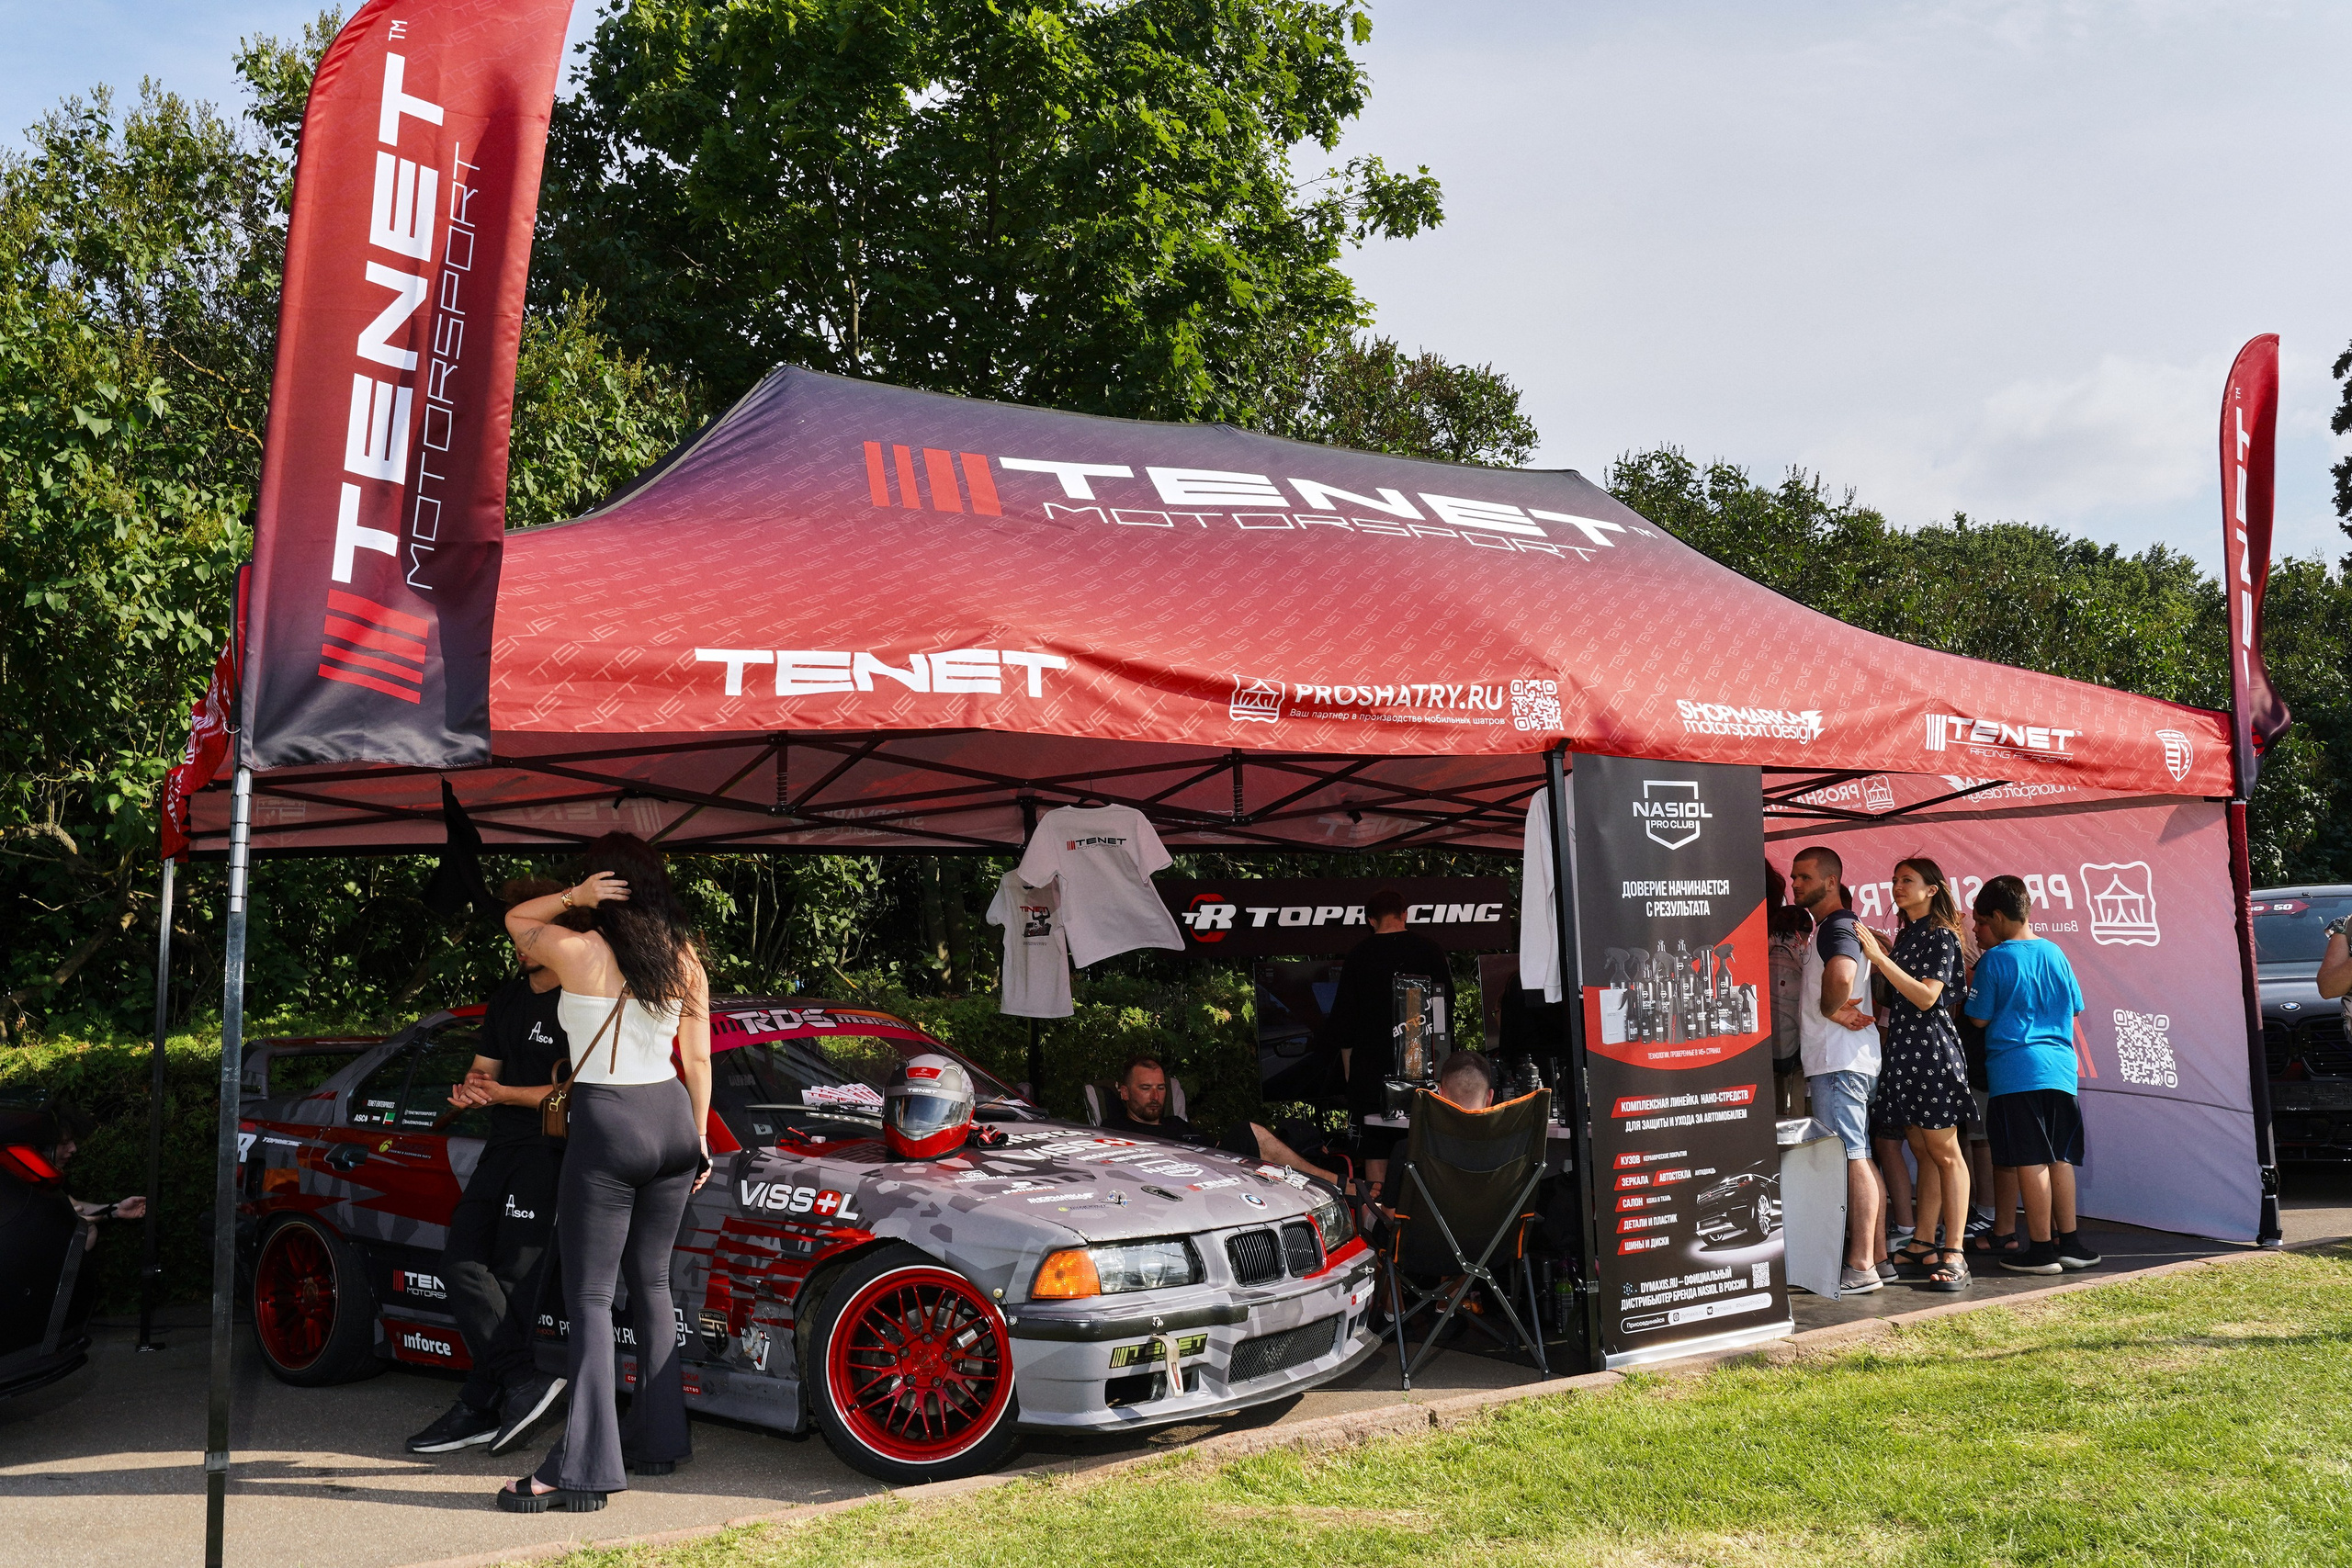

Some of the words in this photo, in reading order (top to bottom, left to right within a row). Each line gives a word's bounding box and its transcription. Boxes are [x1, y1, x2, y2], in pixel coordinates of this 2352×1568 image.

[331, 52, 444, 583] TENET
[407, 142, 480, 590] MOTORSPORT
[998, 457, 1629, 547] TENET
[1043, 502, 1599, 562] MOTORSPORT
[695, 648, 1069, 698] TENET
[1294, 683, 1503, 710] PROSHATRY.RU
[1289, 708, 1309, 717] Ваш
[1312, 711, 1349, 721] партнер
[1359, 713, 1422, 723] производстве
[1424, 715, 1471, 725] мобильных
[1473, 716, 1505, 726] шатров
[1677, 699, 1808, 725] SHOPMARKA
[1683, 720, 1771, 740] motorsport
[1771, 721, 1818, 745] design
[1947, 716, 2075, 750] TENET
[1970, 747, 2011, 760] RACING
[2012, 751, 2074, 764] ACADEMY
[1633, 801, 1713, 818] NASIOL
[1650, 819, 1669, 829] PRO
[1669, 819, 1695, 829] CLUB
[1075, 837, 1127, 846] TENET
[1622, 880, 1668, 898] ДОВЕРИЕ
[1668, 879, 1730, 896] НАЧИНАЕТСЯ
[1246, 903, 1503, 928] TOPRCING
[1645, 902, 1653, 917] С
[1654, 900, 1711, 917] РЕЗУЛЬТАТА
[1621, 1098, 1670, 1112] КОМПЛЕКСНАЯ
[1670, 1093, 1699, 1108] ЛИНЕЙКА
[1625, 1120, 1641, 1133] ДЛЯ
[1642, 1118, 1669, 1131] ЗАЩИТЫ
[1674, 1115, 1695, 1127] УХОДА
[1695, 1113, 1703, 1123] ЗА
[1704, 1109, 1747, 1122] АВТОМОБИЛЕМ
[1621, 1155, 1641, 1166] КУЗОВ
[1622, 1175, 1649, 1187] ЗЕРКАЛА
[1658, 1169, 1692, 1182] АВТОСТЕКЛА
[1623, 1197, 1644, 1208] САЛОН
[1623, 1217, 1647, 1230] ДЕТАЛИ
[1653, 1213, 1678, 1226] ПЛАСТИК
[1624, 1239, 1645, 1251] ШИНЫ
[1645, 1238, 1650, 1248] И
[1650, 1236, 1669, 1249] ДИСКИ
[404, 1271, 447, 1291] TEN
[1640, 1277, 1679, 1293] DYMAXIS.RU
[1684, 1266, 1732, 1286] ОФИЦИАЛЬНЫЙ
[406, 1287, 448, 1300] MOTORS
[1621, 1293, 1672, 1312] ДИСТРИБЬЮТЕР
[1673, 1289, 1697, 1302] БРЕНДА
[1697, 1285, 1718, 1298] NASIOL
[1724, 1278, 1747, 1292] РОССИИ
[1129, 1334, 1207, 1358] TEET
